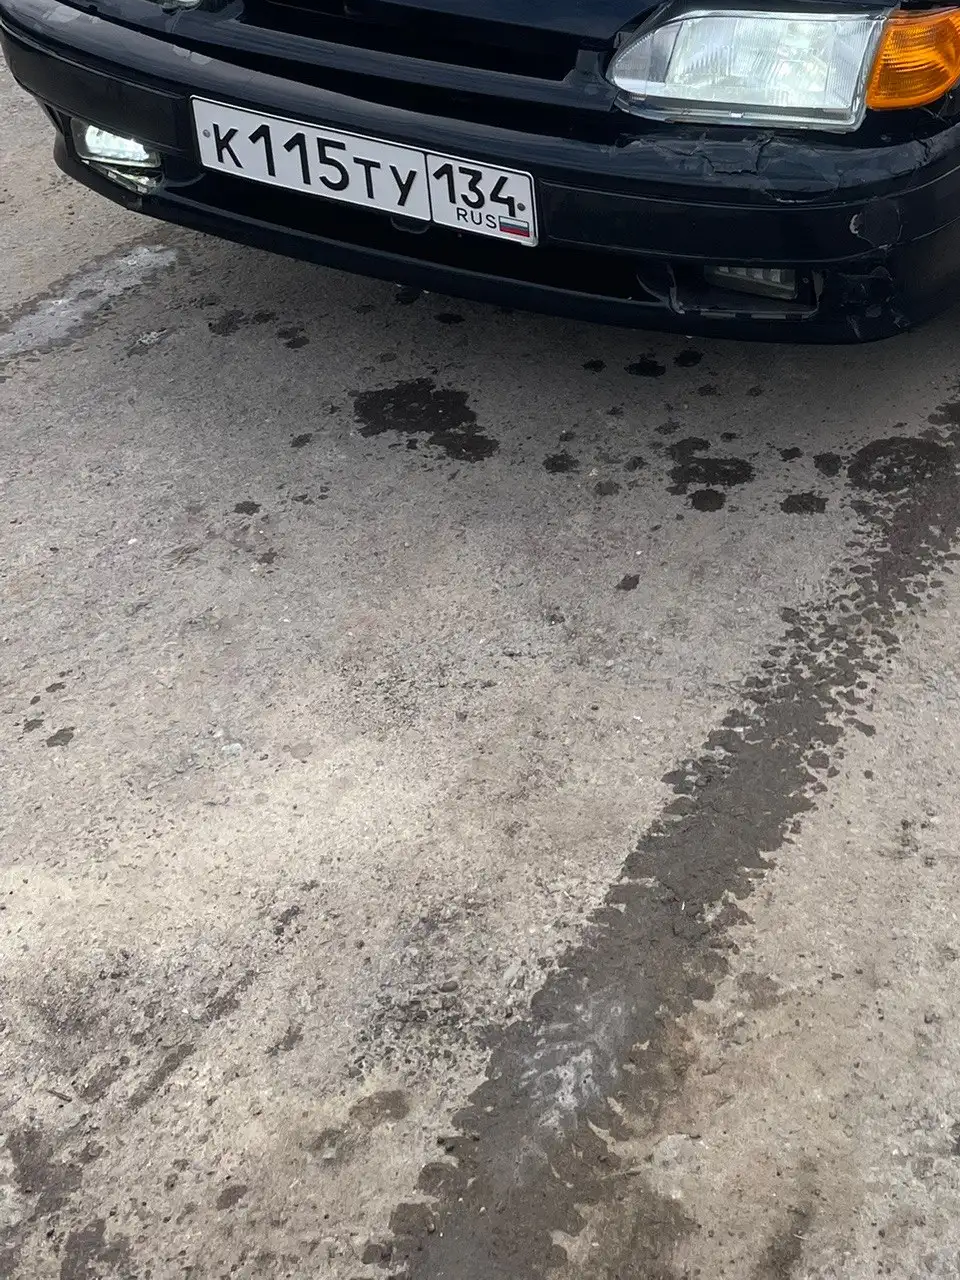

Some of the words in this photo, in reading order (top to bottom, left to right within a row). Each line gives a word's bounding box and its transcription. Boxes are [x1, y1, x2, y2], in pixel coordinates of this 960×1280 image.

[212, 123, 417, 207] К115ТУ
[432, 162, 517, 218] 134
[456, 207, 497, 229] RUS
